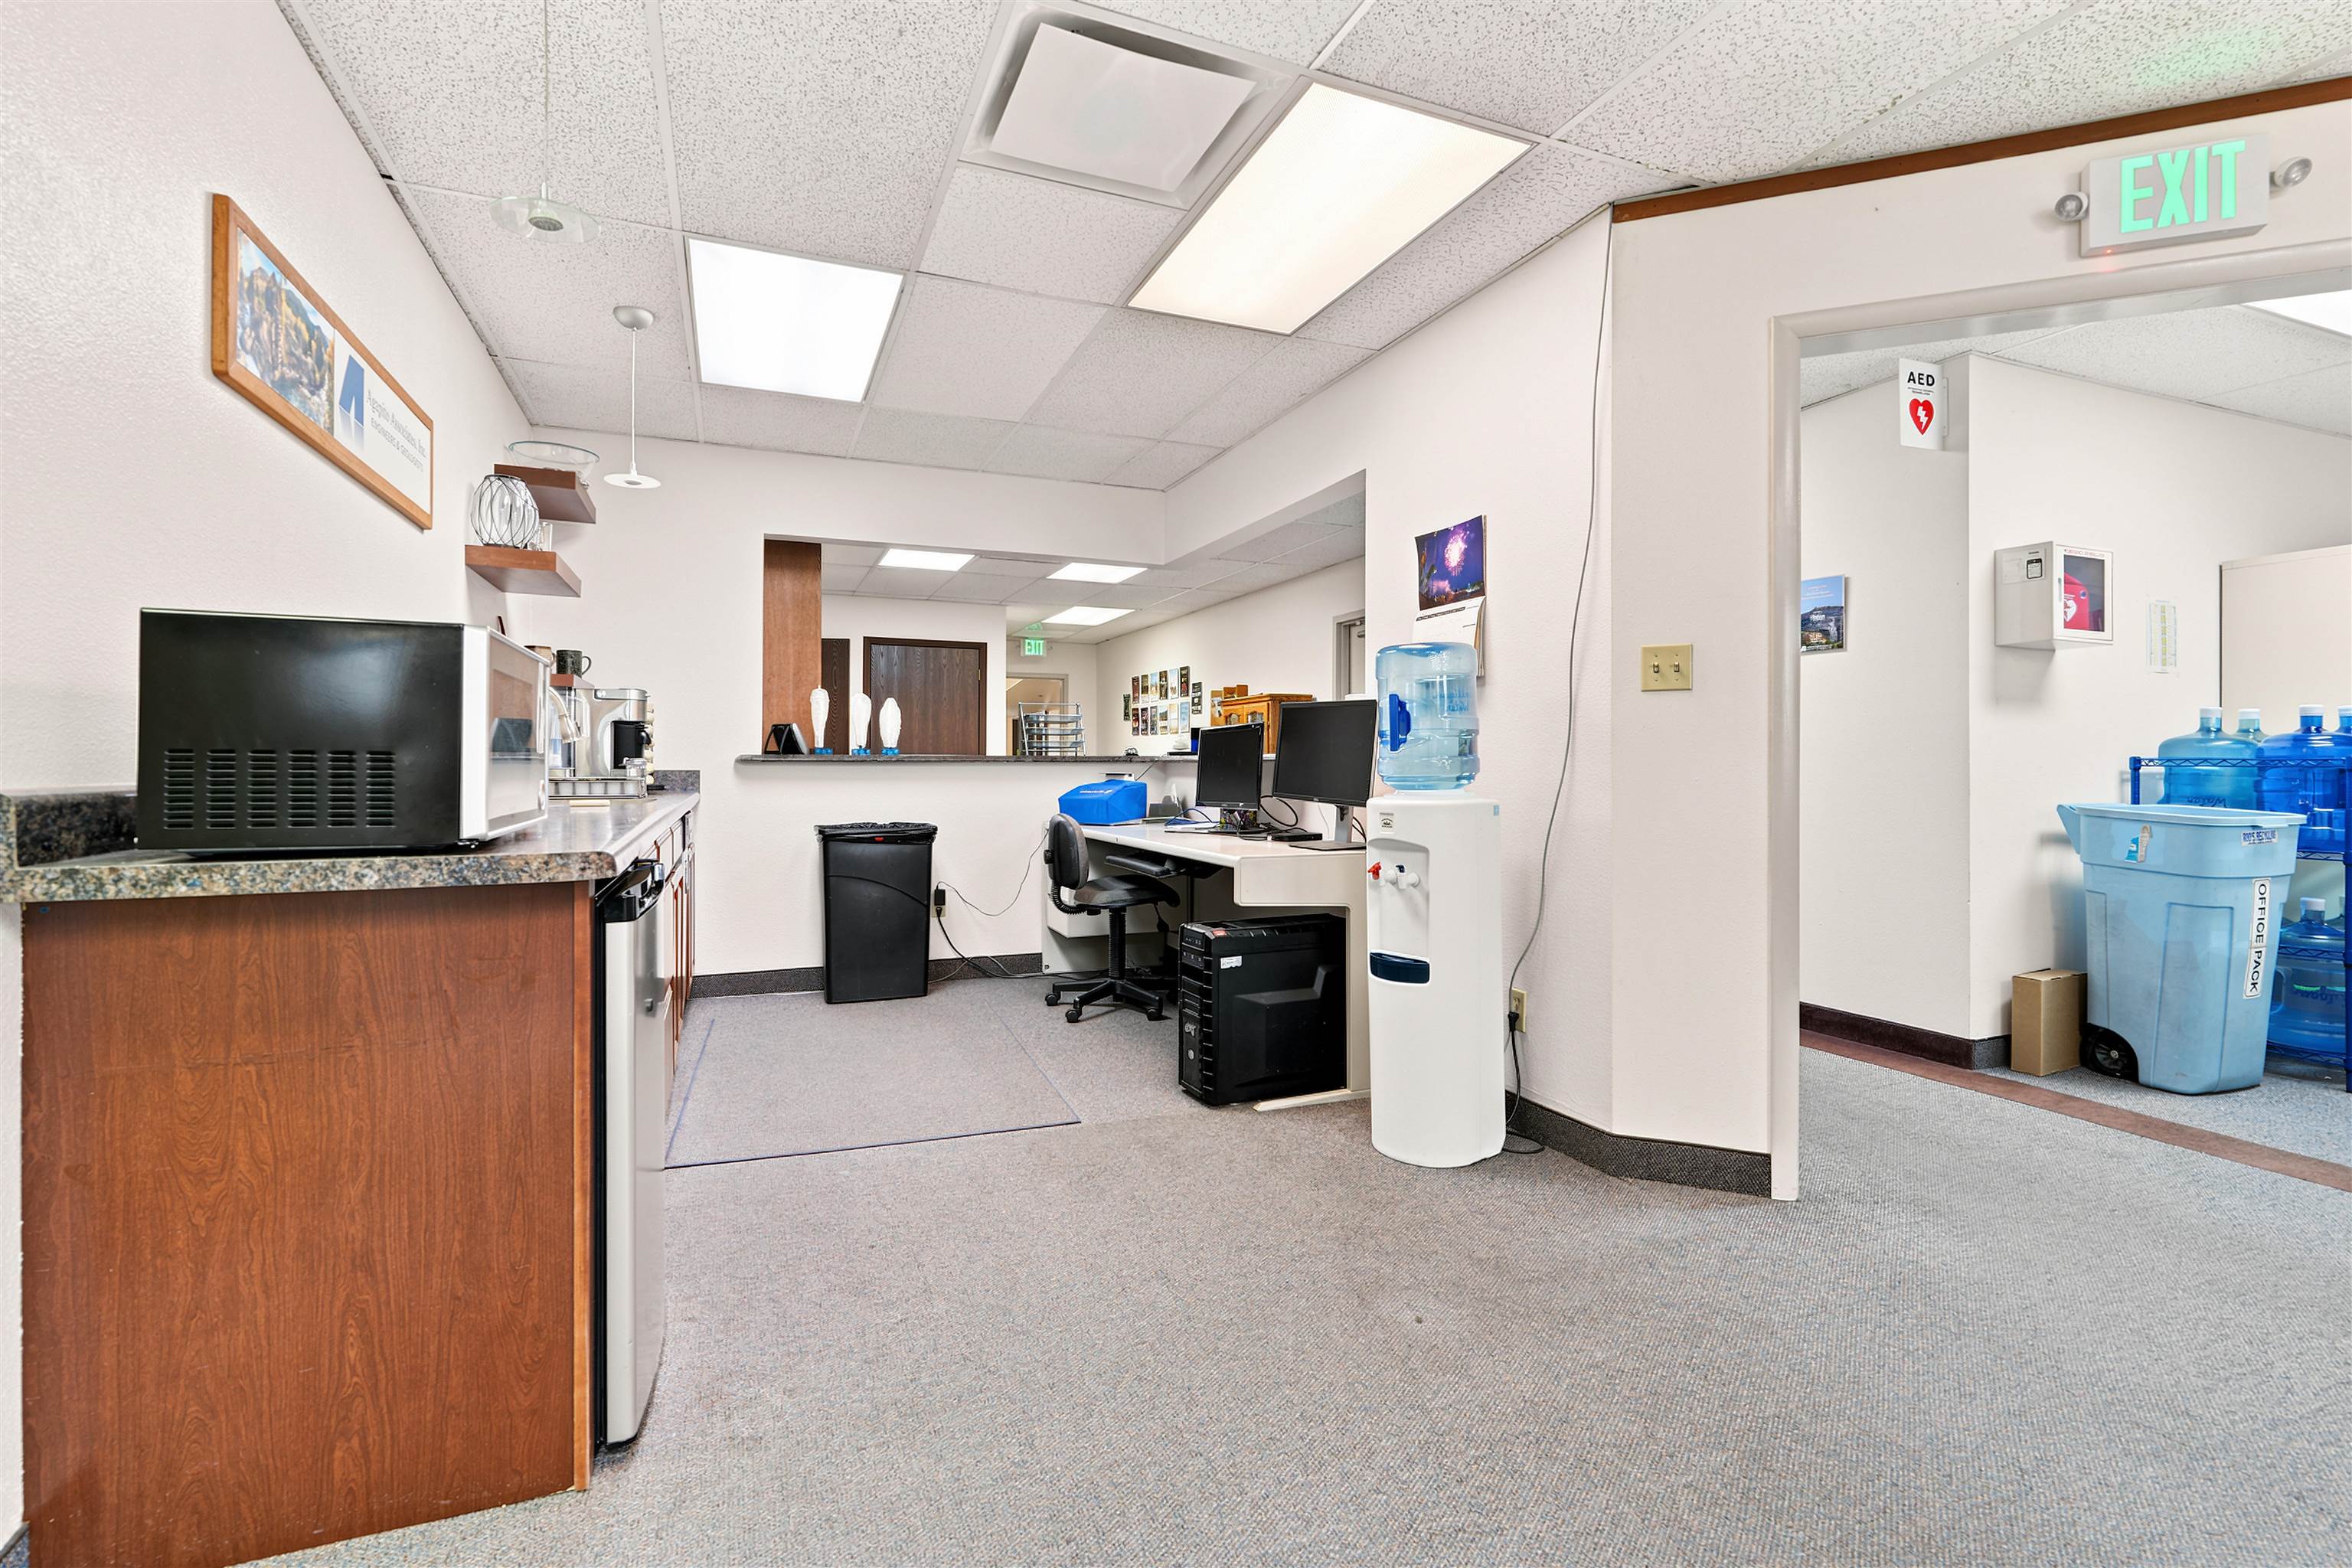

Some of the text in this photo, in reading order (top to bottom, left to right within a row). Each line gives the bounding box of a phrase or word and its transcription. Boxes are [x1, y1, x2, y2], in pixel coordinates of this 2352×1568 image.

[2120, 139, 2246, 234] EXIT
[1907, 371, 1936, 387] AED
[1024, 639, 1044, 656] EXIT
[2255, 884, 2267, 944] OFFICE
[2249, 949, 2263, 992] PACK
